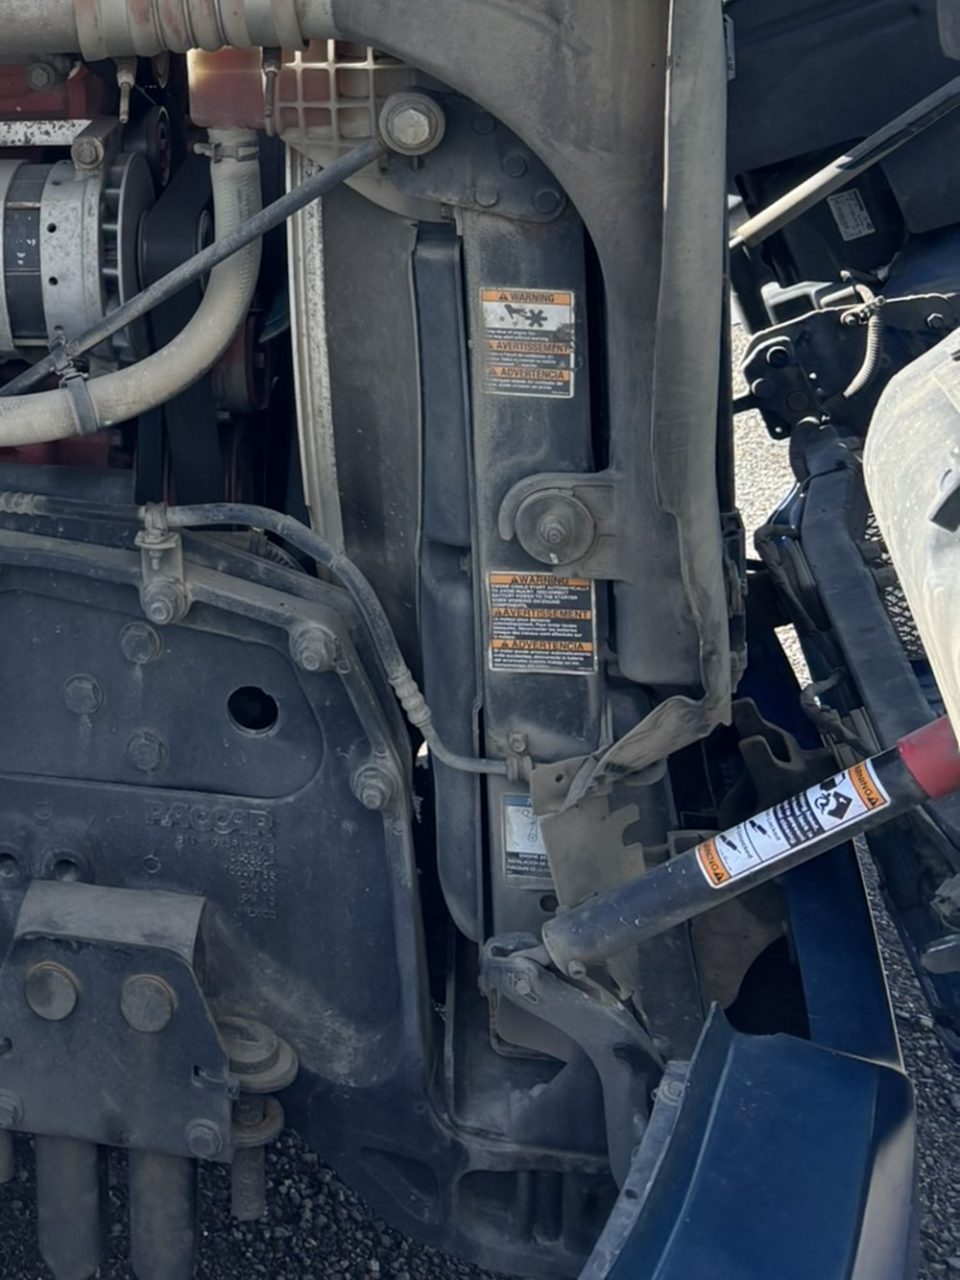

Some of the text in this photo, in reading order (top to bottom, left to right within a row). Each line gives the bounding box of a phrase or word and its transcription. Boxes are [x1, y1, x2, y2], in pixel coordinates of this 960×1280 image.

[512, 293, 554, 303] WARNING
[501, 368, 564, 380] ADVERTENCIA
[517, 576, 569, 585] WARNING
[503, 609, 587, 618] AVERTISSEMENT
[512, 641, 583, 650] ADVERTENCIA
[144, 801, 273, 835] PACCAR
